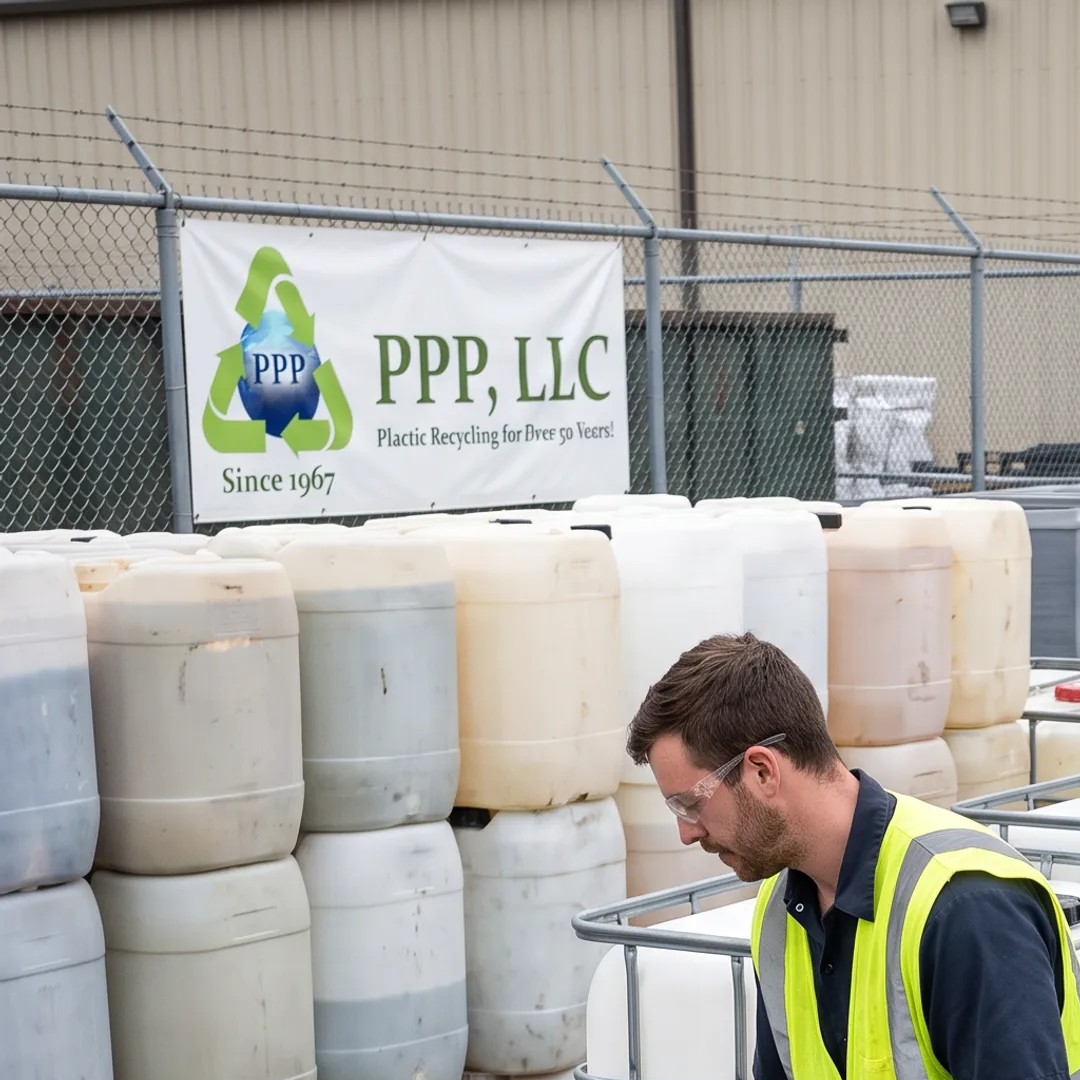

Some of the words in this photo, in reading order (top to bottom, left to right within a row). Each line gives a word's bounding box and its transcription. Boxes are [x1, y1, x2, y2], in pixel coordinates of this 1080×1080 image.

[252, 353, 306, 384] PPP
[373, 335, 497, 416] PPP,
[514, 335, 611, 402] LLC
[431, 425, 499, 450] Recycling
[502, 424, 522, 443] for
[559, 427, 574, 446] 50
[222, 467, 284, 494] Since
[289, 464, 336, 498] 1967
